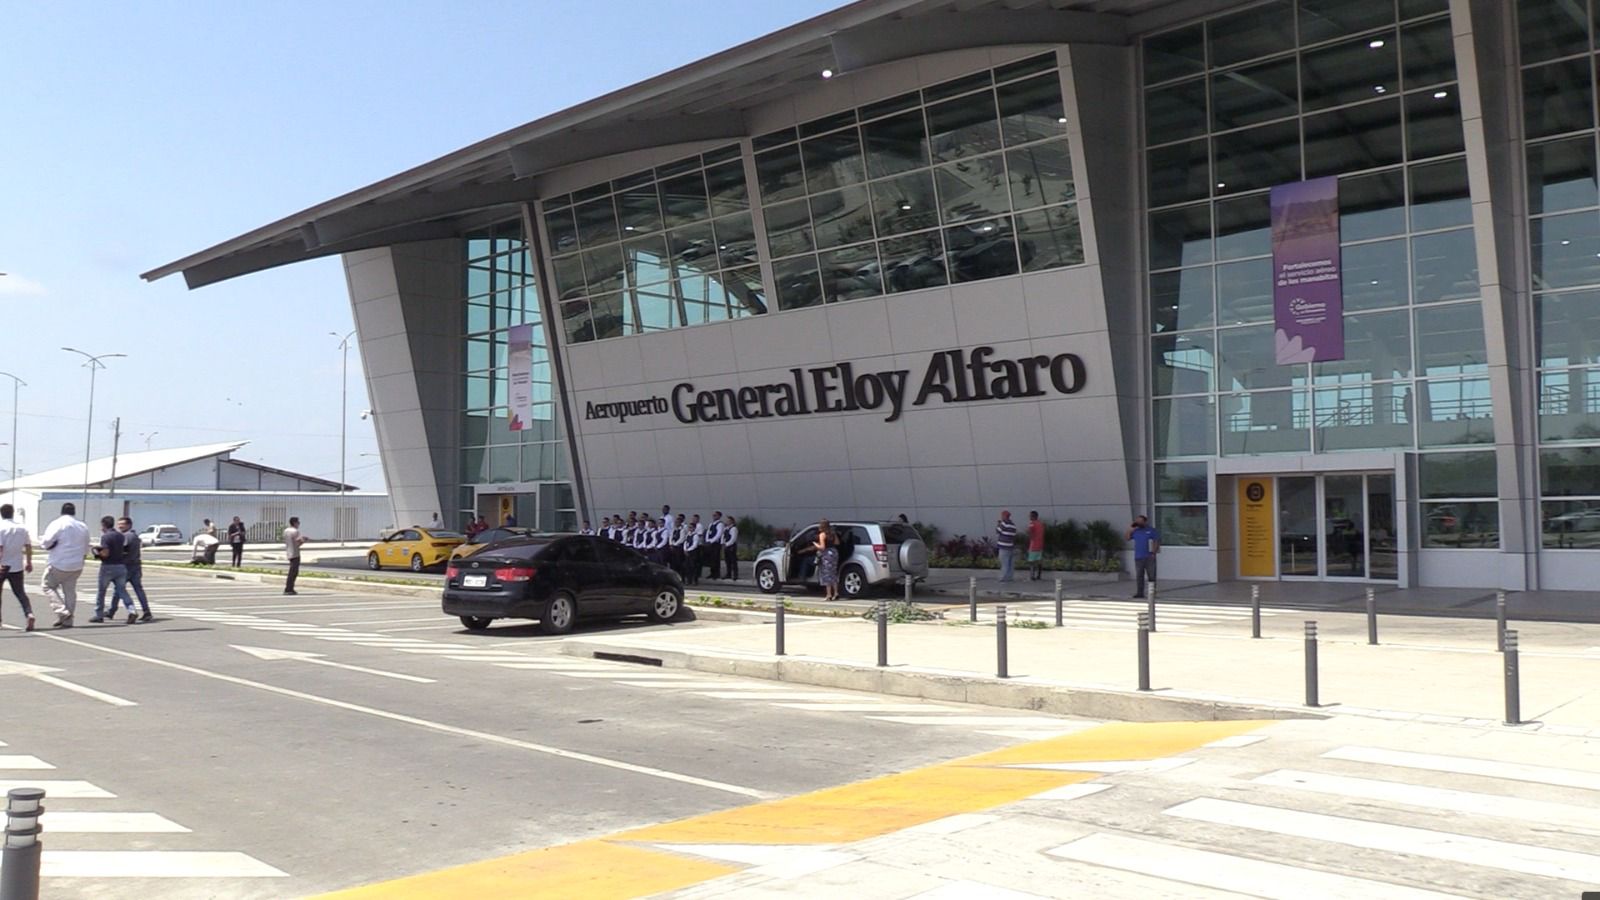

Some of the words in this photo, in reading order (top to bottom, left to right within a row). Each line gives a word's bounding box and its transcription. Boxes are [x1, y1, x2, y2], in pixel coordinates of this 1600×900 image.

[585, 395, 668, 423] Aeropuerto
[671, 368, 812, 424] General
[808, 362, 910, 422] Eloy
[912, 346, 1087, 405] Alfaro
